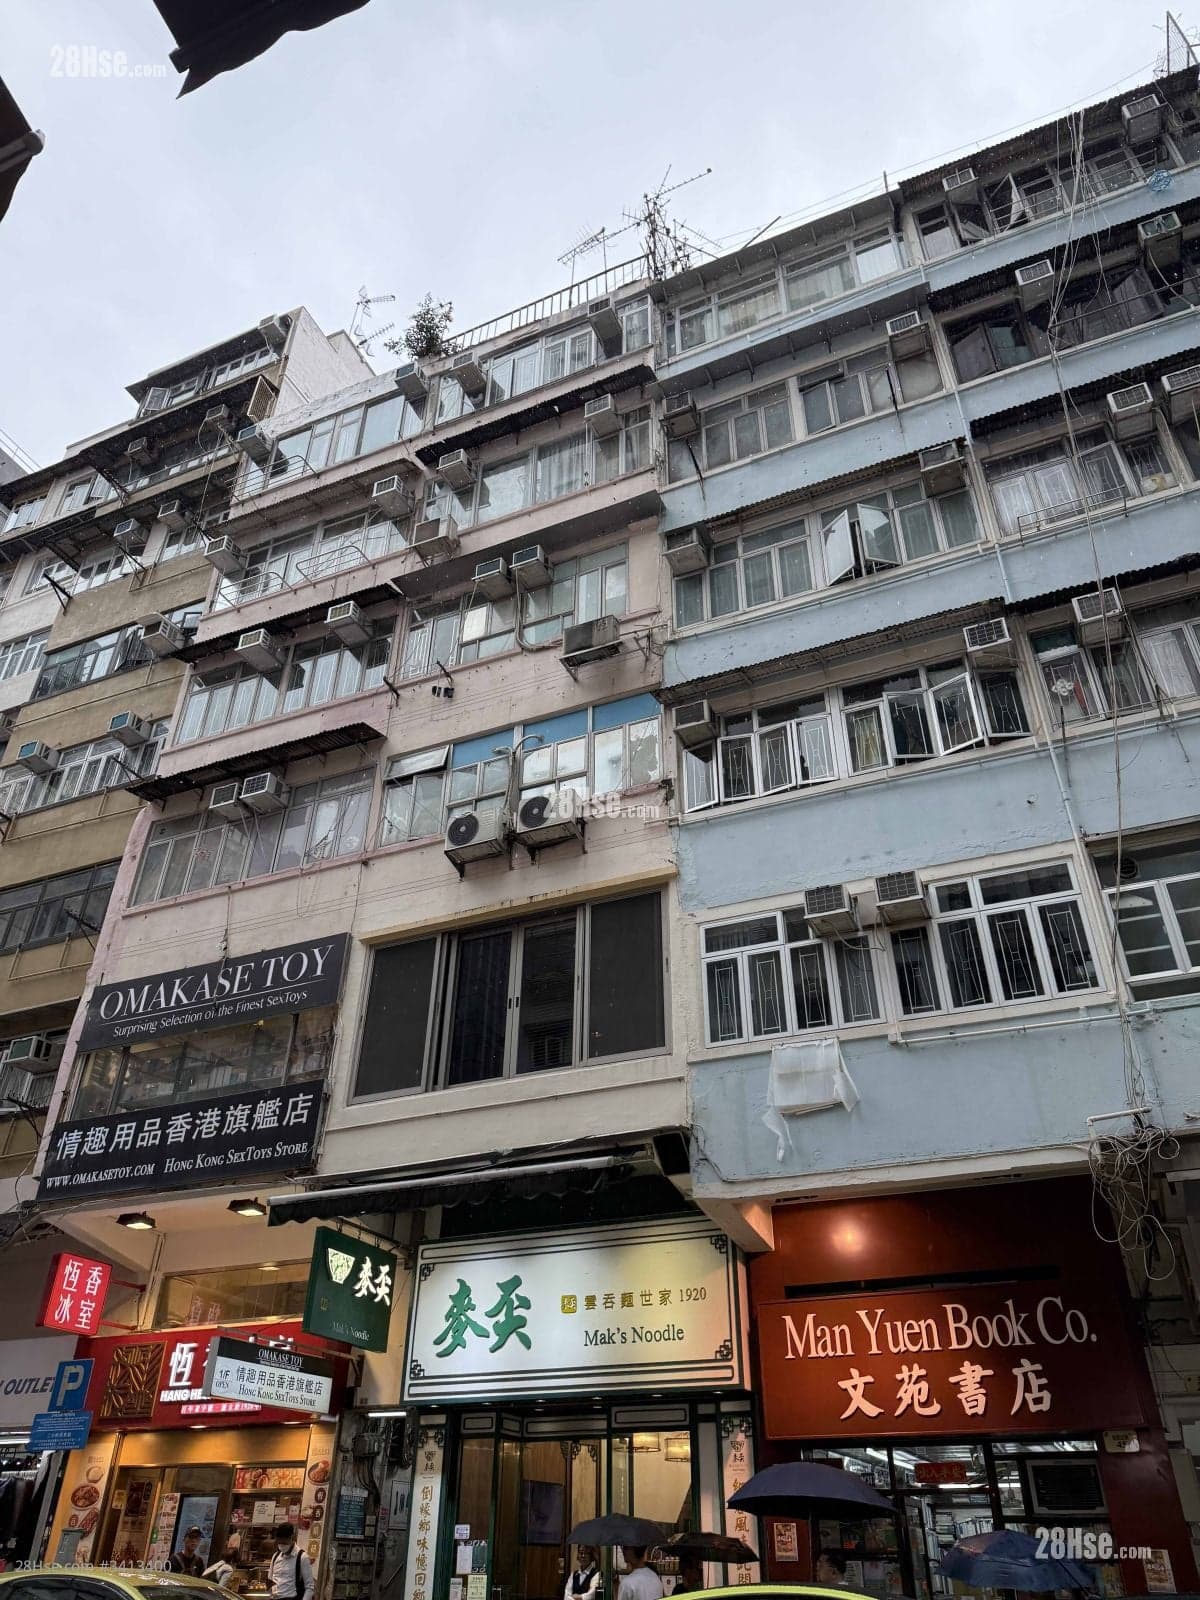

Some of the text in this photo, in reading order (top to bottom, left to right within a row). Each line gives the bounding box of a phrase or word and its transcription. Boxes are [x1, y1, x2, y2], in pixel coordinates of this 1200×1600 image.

[100, 944, 335, 1020] OMAKASE TOY
[113, 1020, 158, 1038] Surprising
[160, 1009, 202, 1028] Selection
[218, 1002, 233, 1017] the
[235, 997, 264, 1015] Finest
[55, 1093, 314, 1161] 情趣用品香港旗艦店
[679, 1286, 707, 1303] 1920
[584, 1324, 685, 1347] Mak's Noodle
[781, 1296, 1097, 1360] Man Yuen Book Co.
[259, 1348, 290, 1363] OMAKASE
[291, 1354, 304, 1368] TOY
[219, 1369, 231, 1380] 1/F
[837, 1357, 1051, 1420] 文苑書店
[160, 1389, 189, 1402] HANG
